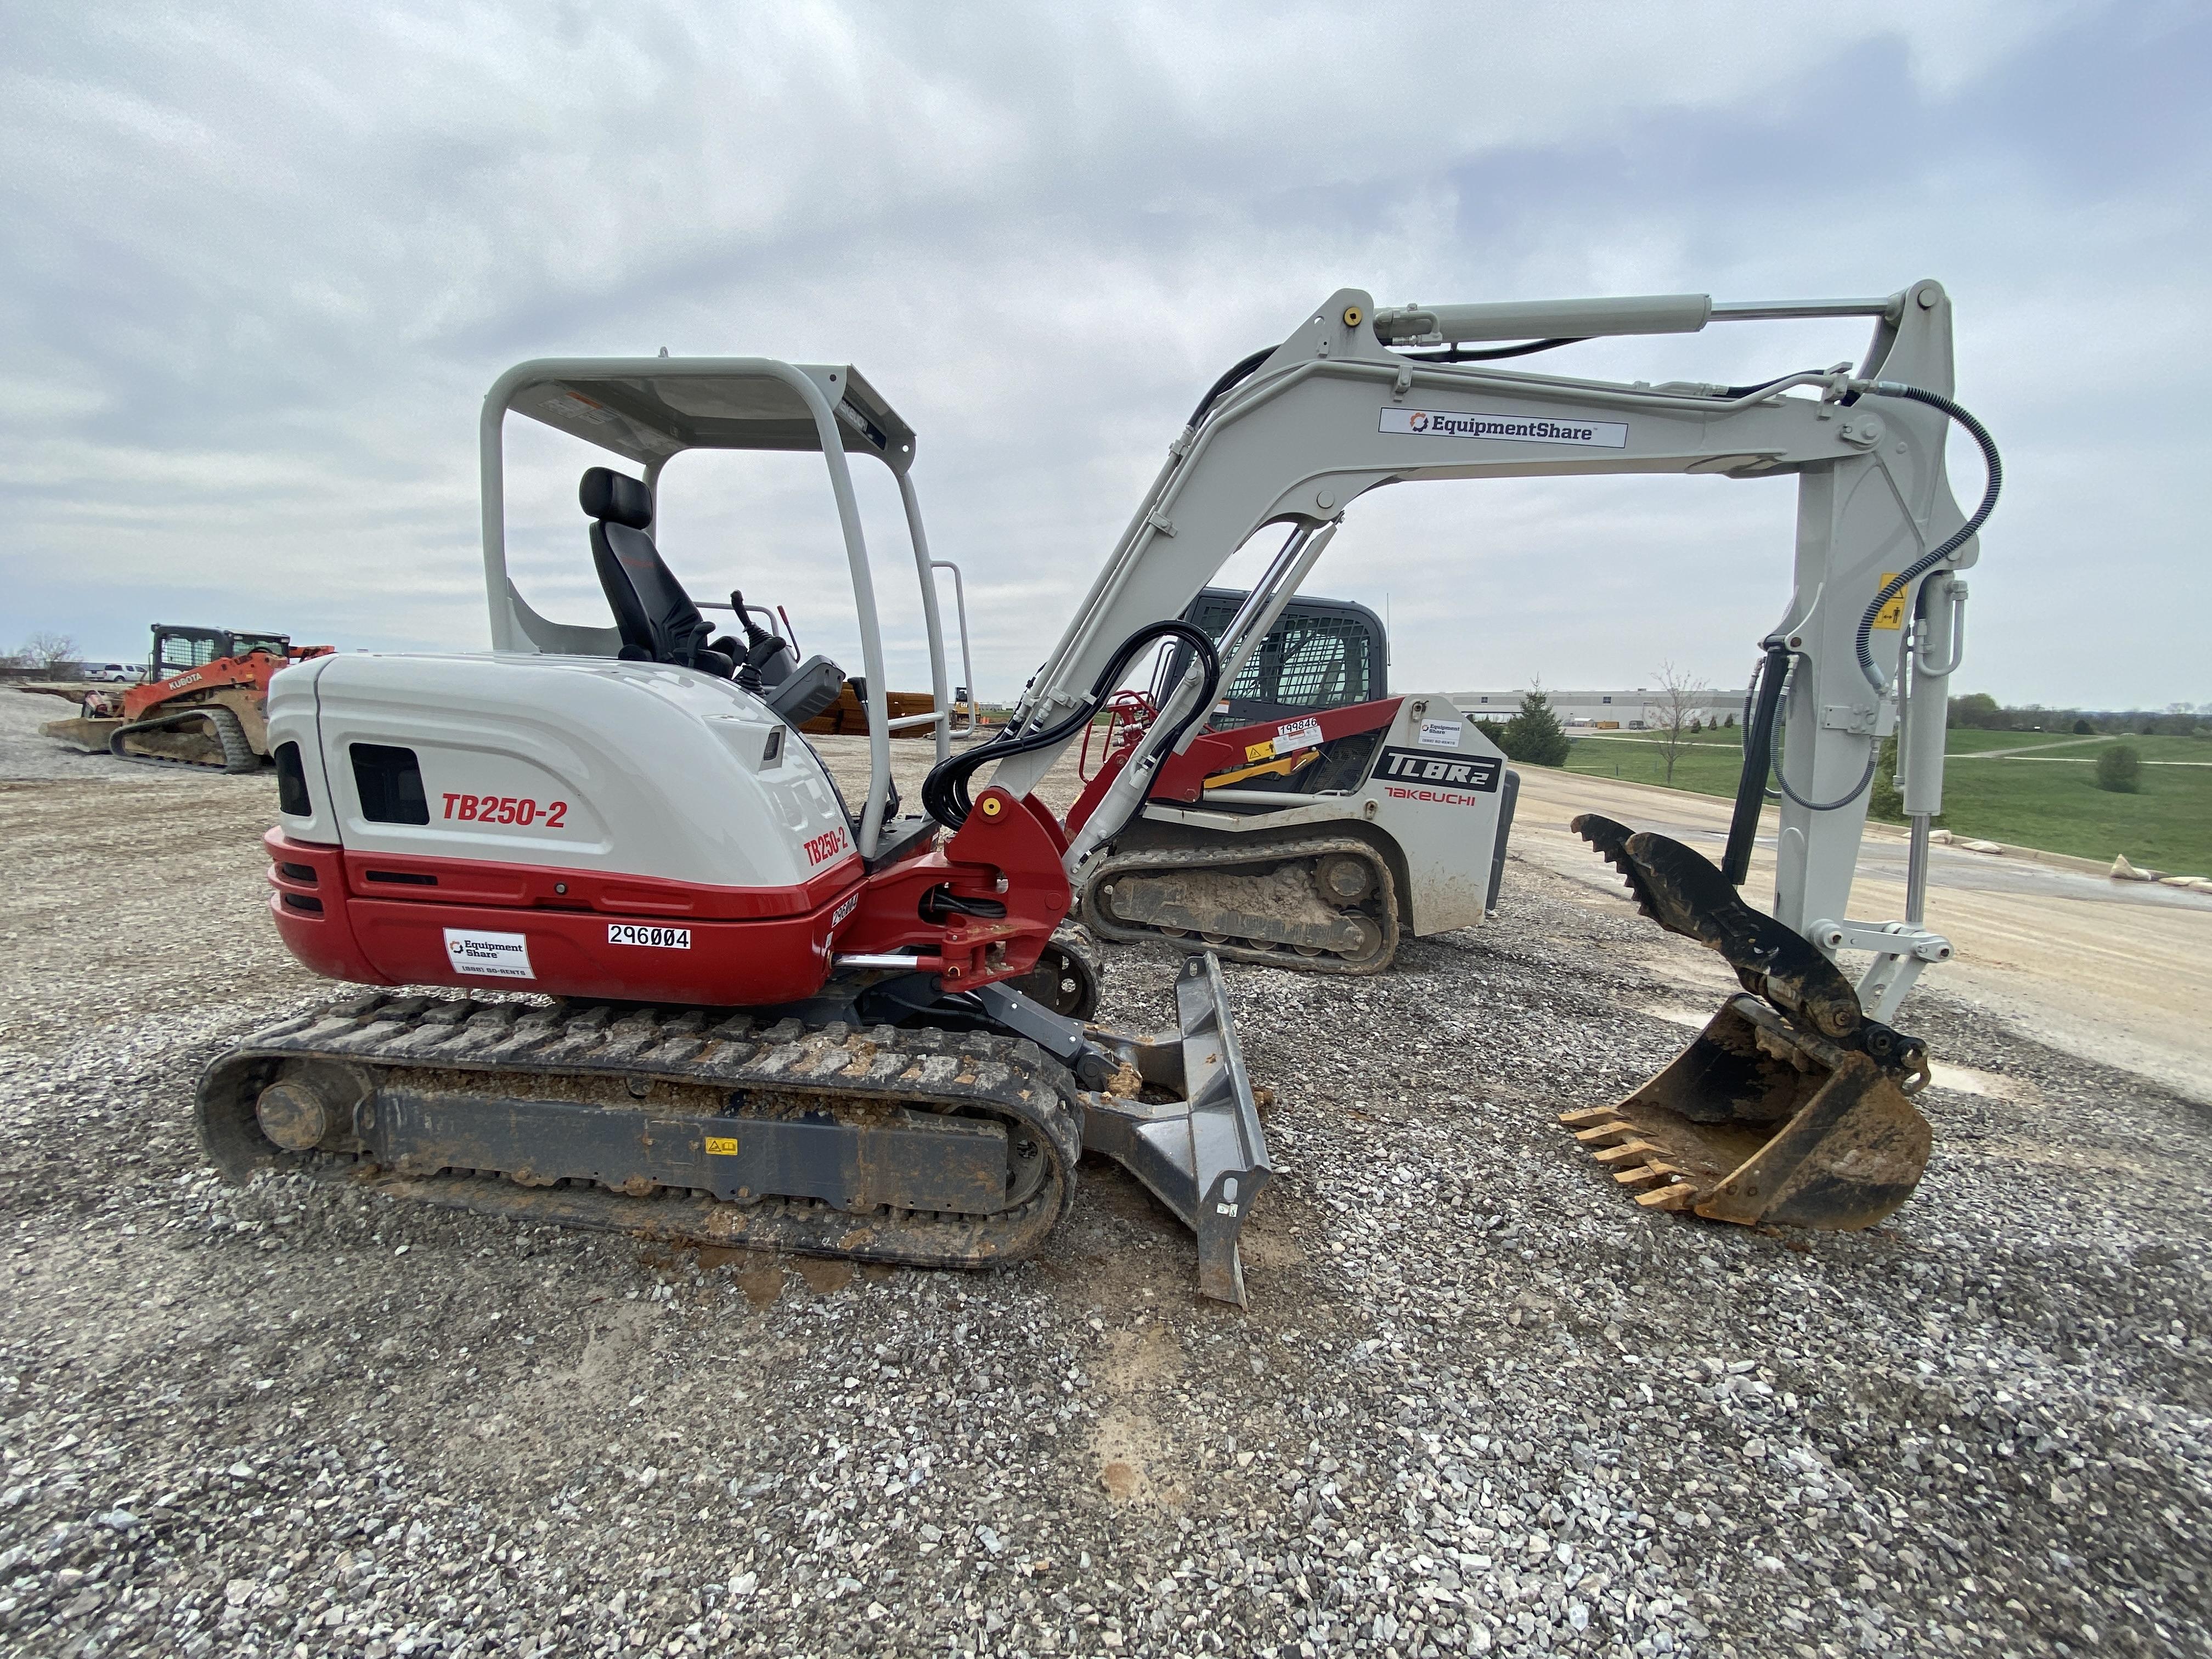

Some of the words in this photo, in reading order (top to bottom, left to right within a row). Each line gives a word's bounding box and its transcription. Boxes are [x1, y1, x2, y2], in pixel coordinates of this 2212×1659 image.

[1432, 415, 1593, 440] EquipmentShare
[168, 673, 203, 690] KUBOTA
[1280, 718, 1317, 734] 199846
[1388, 752, 1495, 785] TL8R2
[1384, 787, 1476, 806] TAKEUCHI
[442, 793, 567, 827] TB250-2
[804, 826, 848, 867] TB250-2
[464, 940, 523, 952] Equipment
[610, 925, 689, 947] 296004
[466, 949, 498, 958] Share
